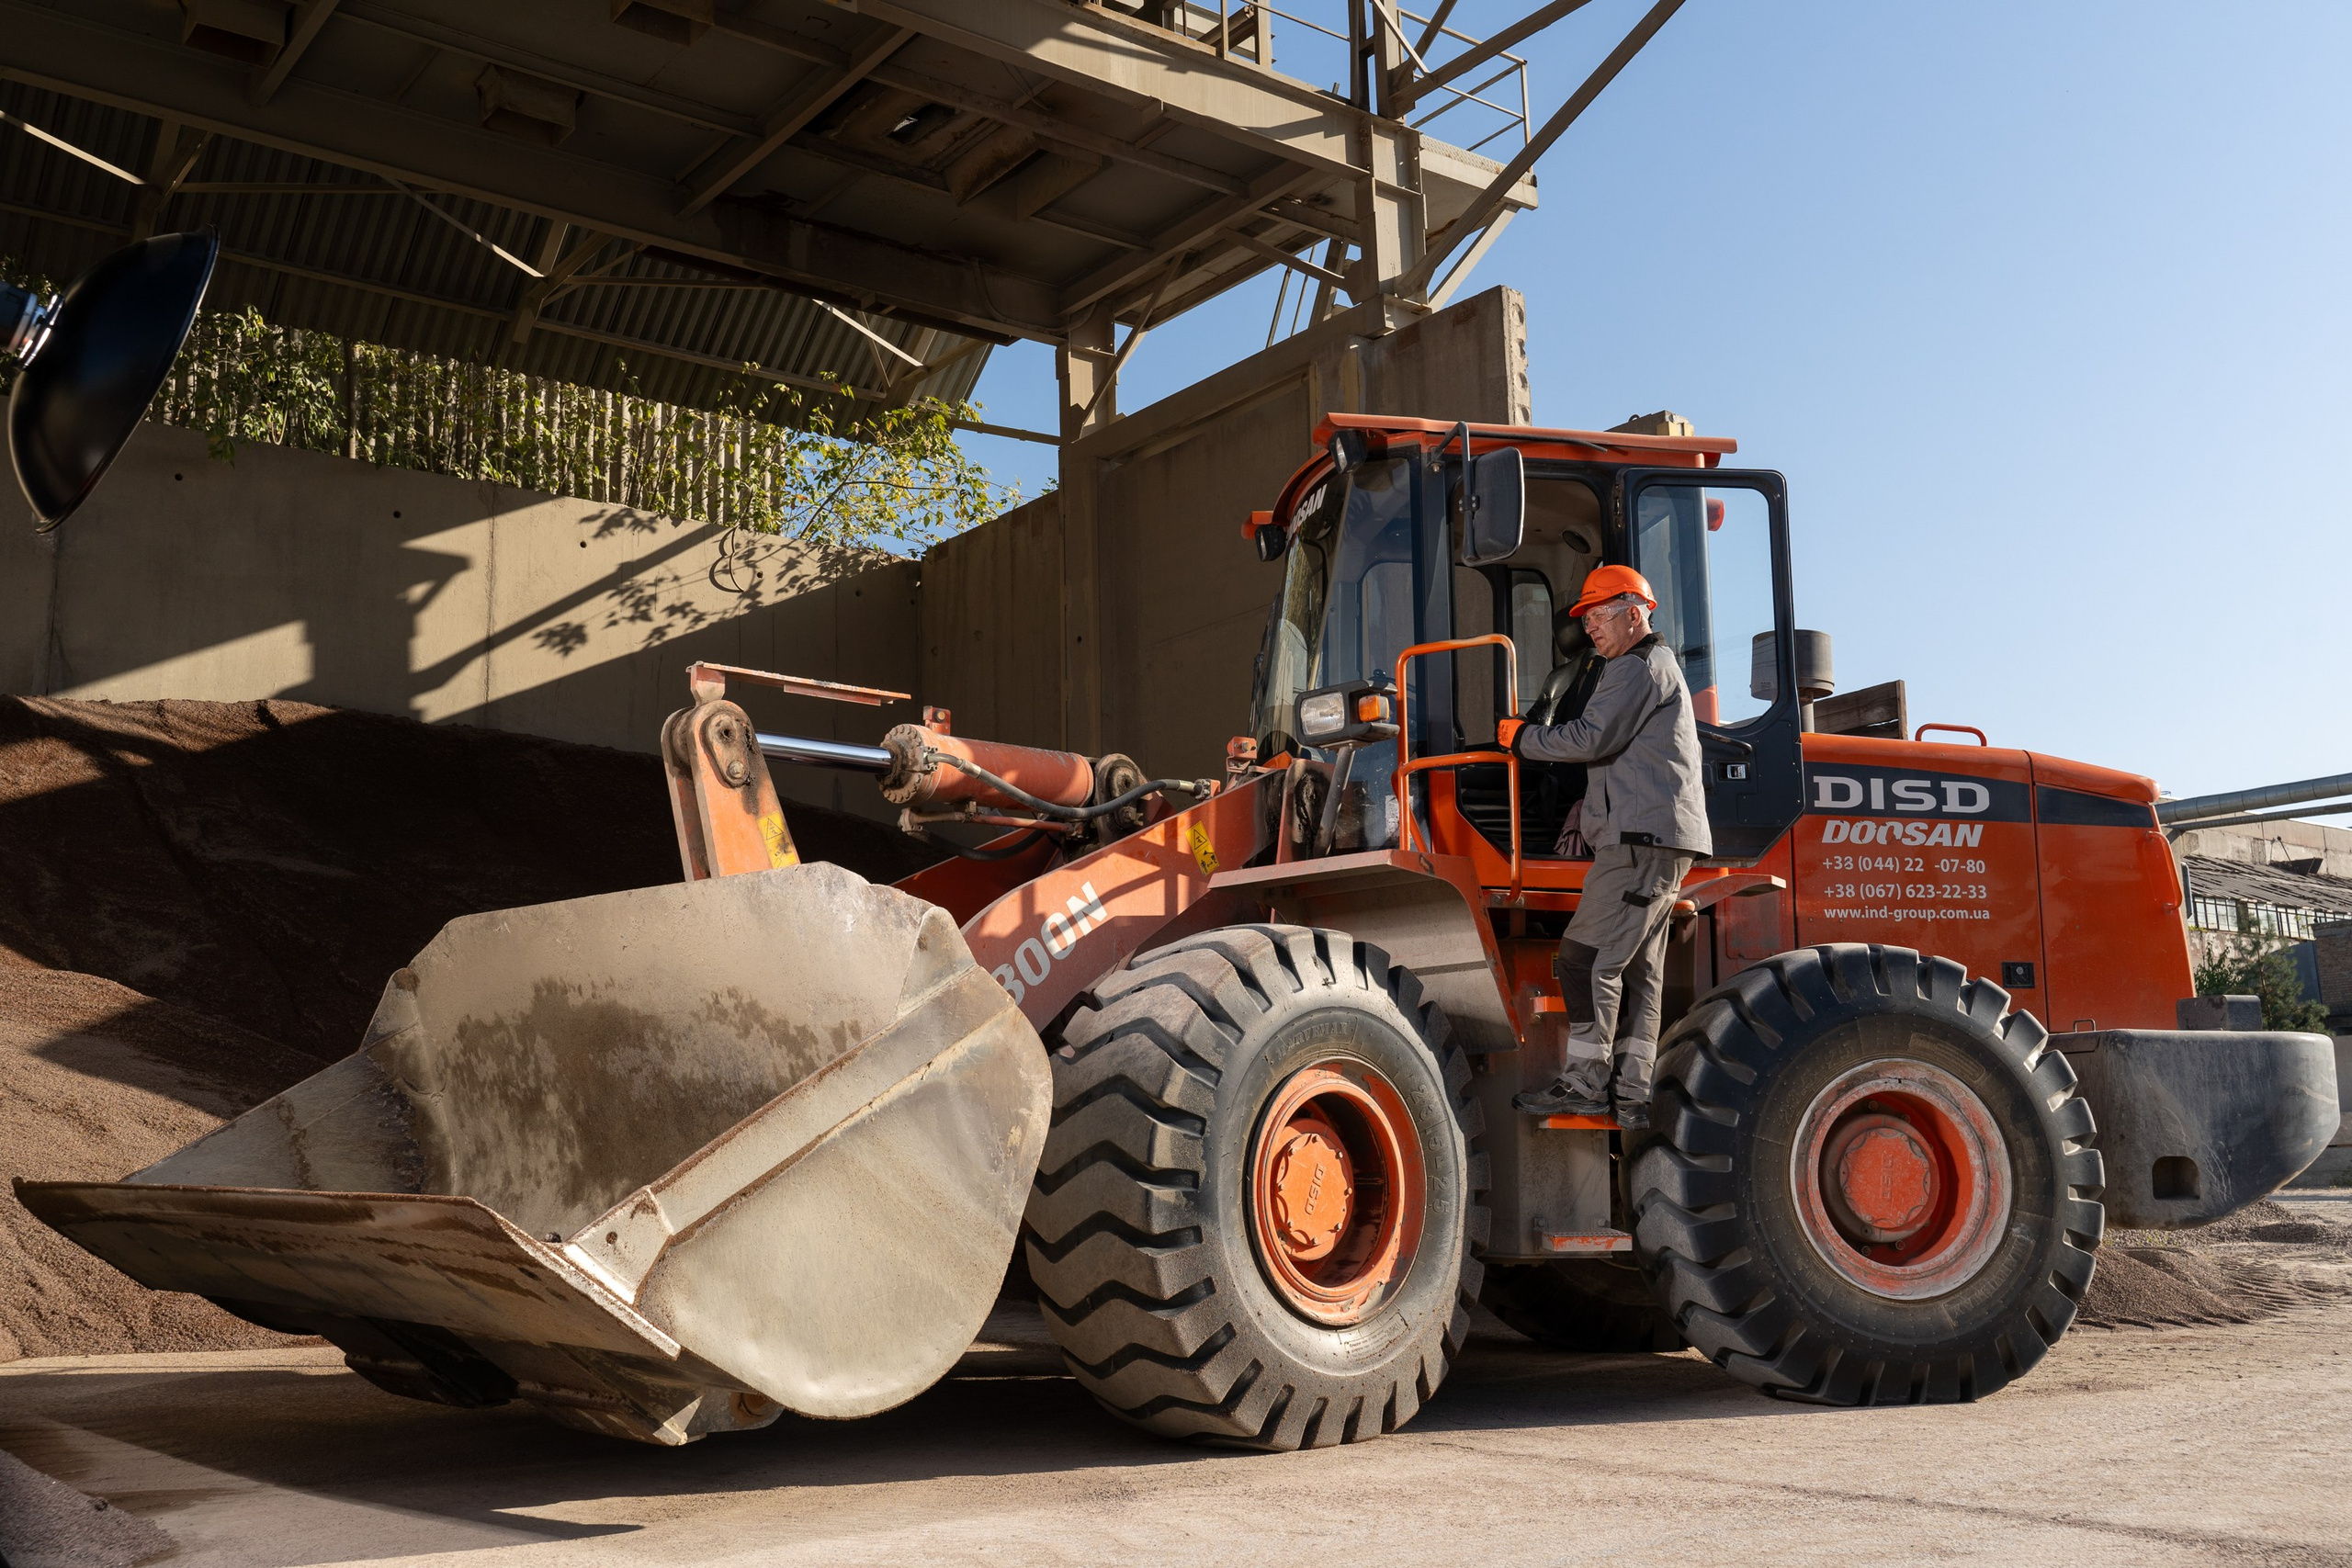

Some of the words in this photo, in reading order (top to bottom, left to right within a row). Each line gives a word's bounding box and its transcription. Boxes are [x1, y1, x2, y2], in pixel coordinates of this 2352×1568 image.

[1813, 775, 1990, 814] DISD
[1858, 855, 1900, 873] (044)
[1824, 884, 1856, 898] +38
[1860, 883, 1902, 900] (067)
[1905, 884, 1987, 899] 623-22-33
[1823, 905, 1990, 922] www.ind-group.com.ua
[1304, 1163, 1325, 1215] DISD
